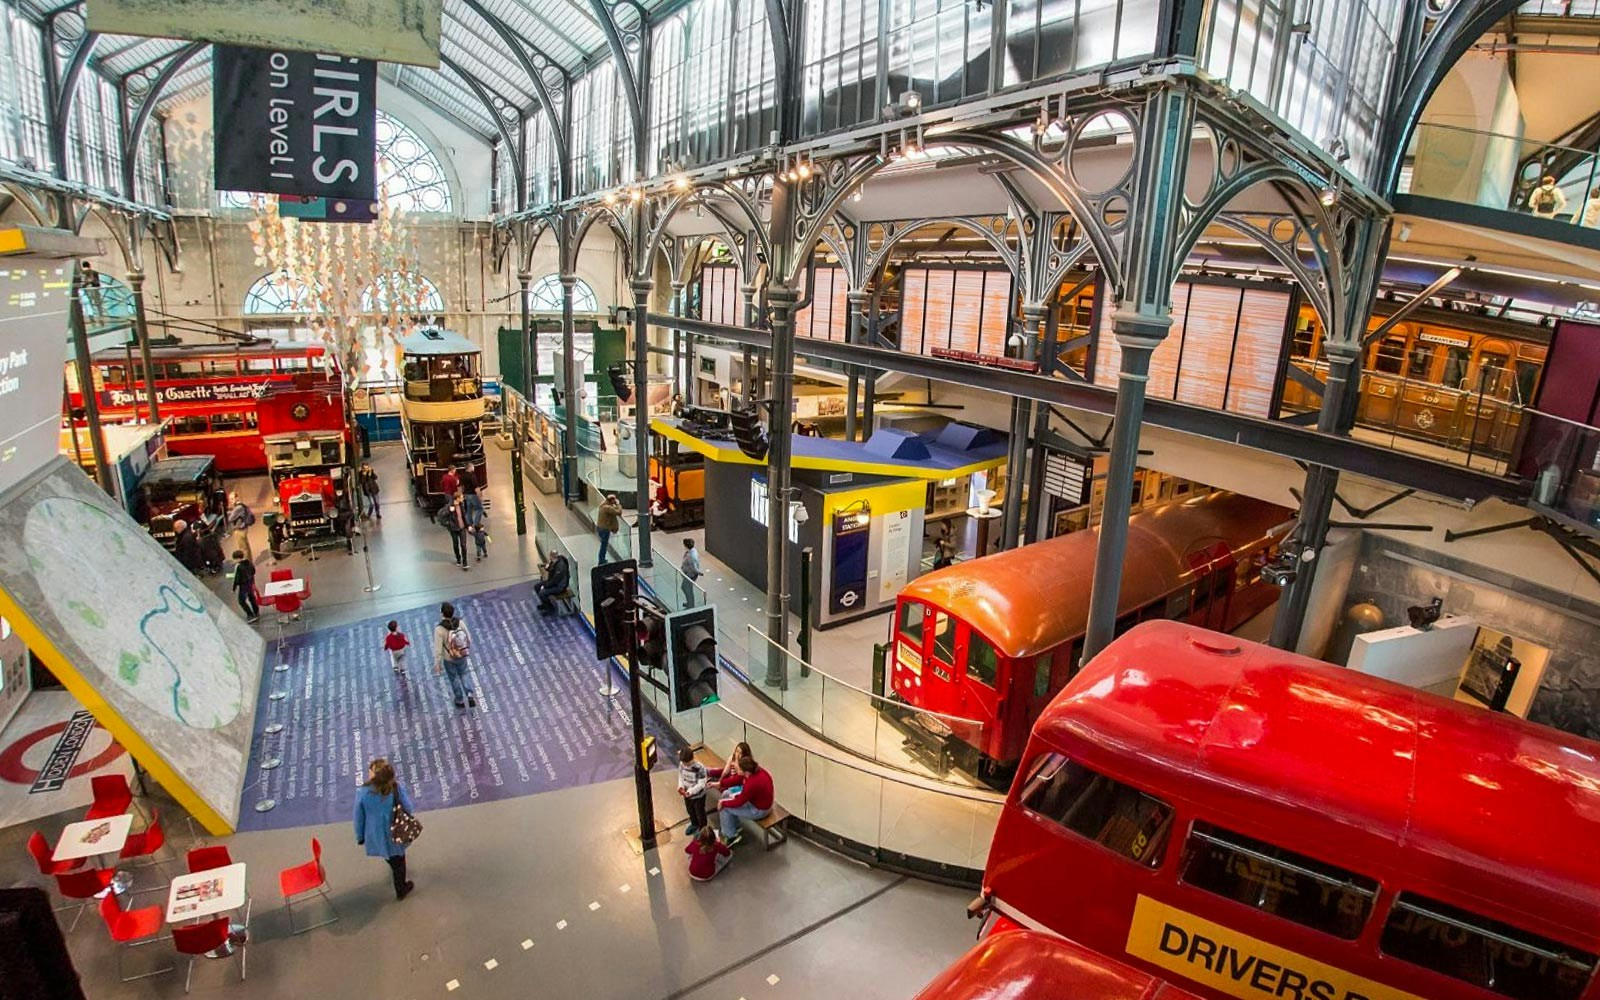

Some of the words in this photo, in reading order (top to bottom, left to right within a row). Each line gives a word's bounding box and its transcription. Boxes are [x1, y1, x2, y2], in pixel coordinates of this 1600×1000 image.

[269, 52, 289, 88] on
[269, 101, 295, 166] level
[165, 386, 212, 402] Gazette
[1158, 922, 1336, 1000] DRIVERS
